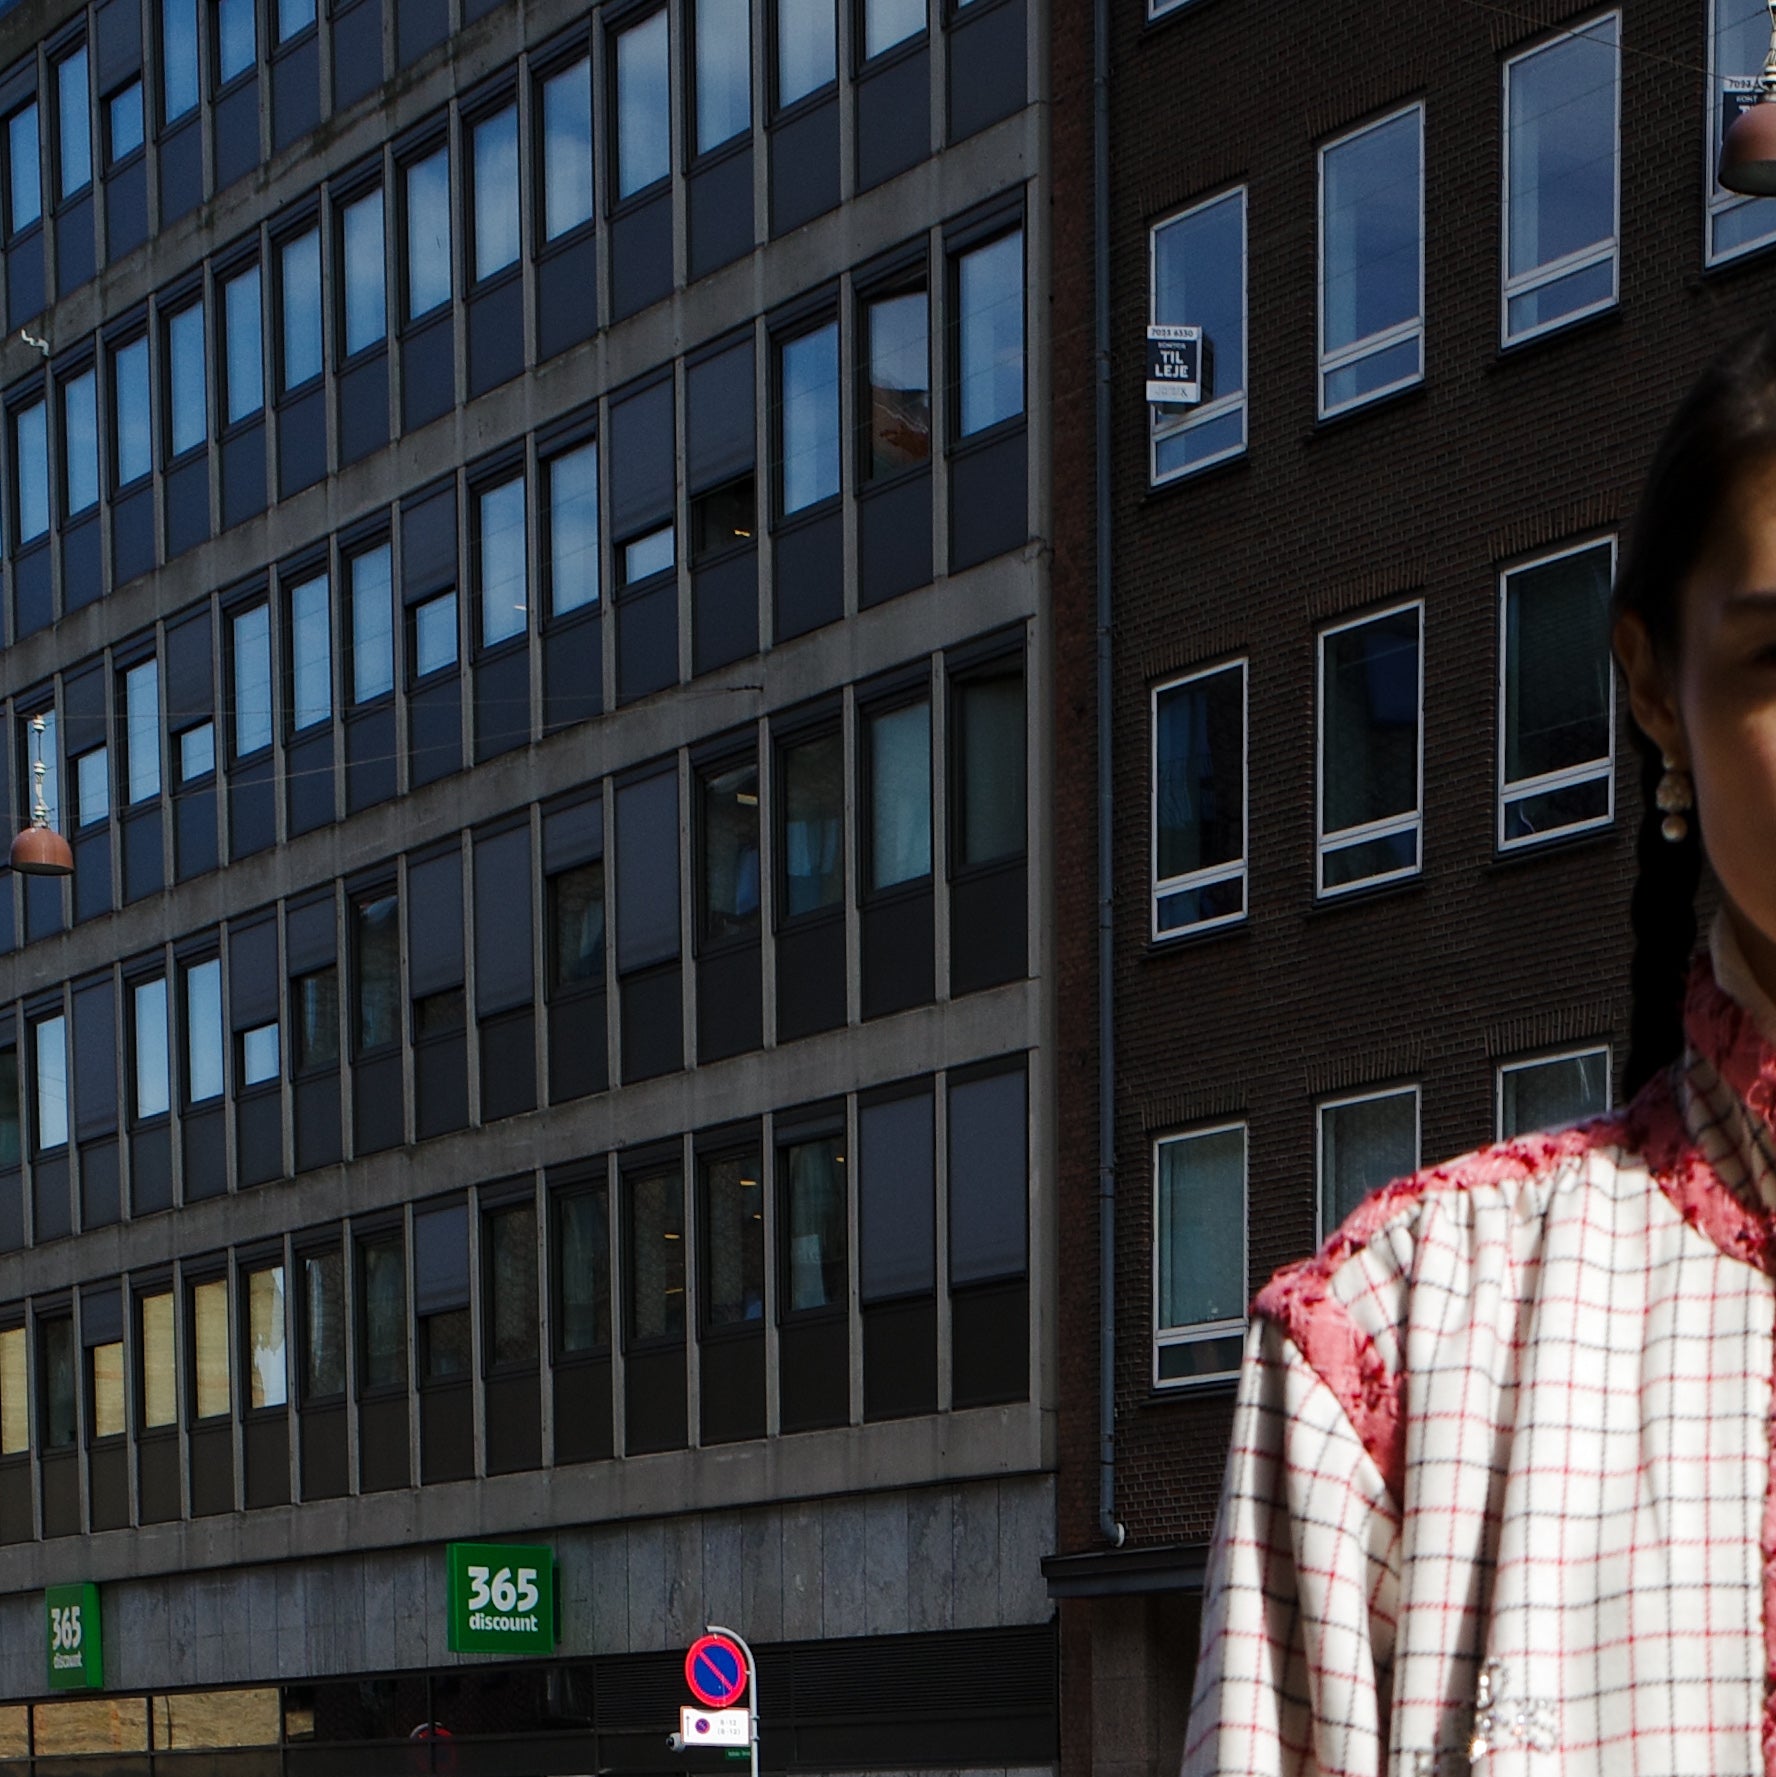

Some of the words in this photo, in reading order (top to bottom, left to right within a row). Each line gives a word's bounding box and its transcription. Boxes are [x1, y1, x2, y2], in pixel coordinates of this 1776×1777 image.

[1161, 351, 1183, 364] TIL
[1154, 364, 1189, 379] LEJE
[467, 1565, 540, 1613] 365
[50, 1605, 82, 1650] 365
[469, 1612, 540, 1633] discount
